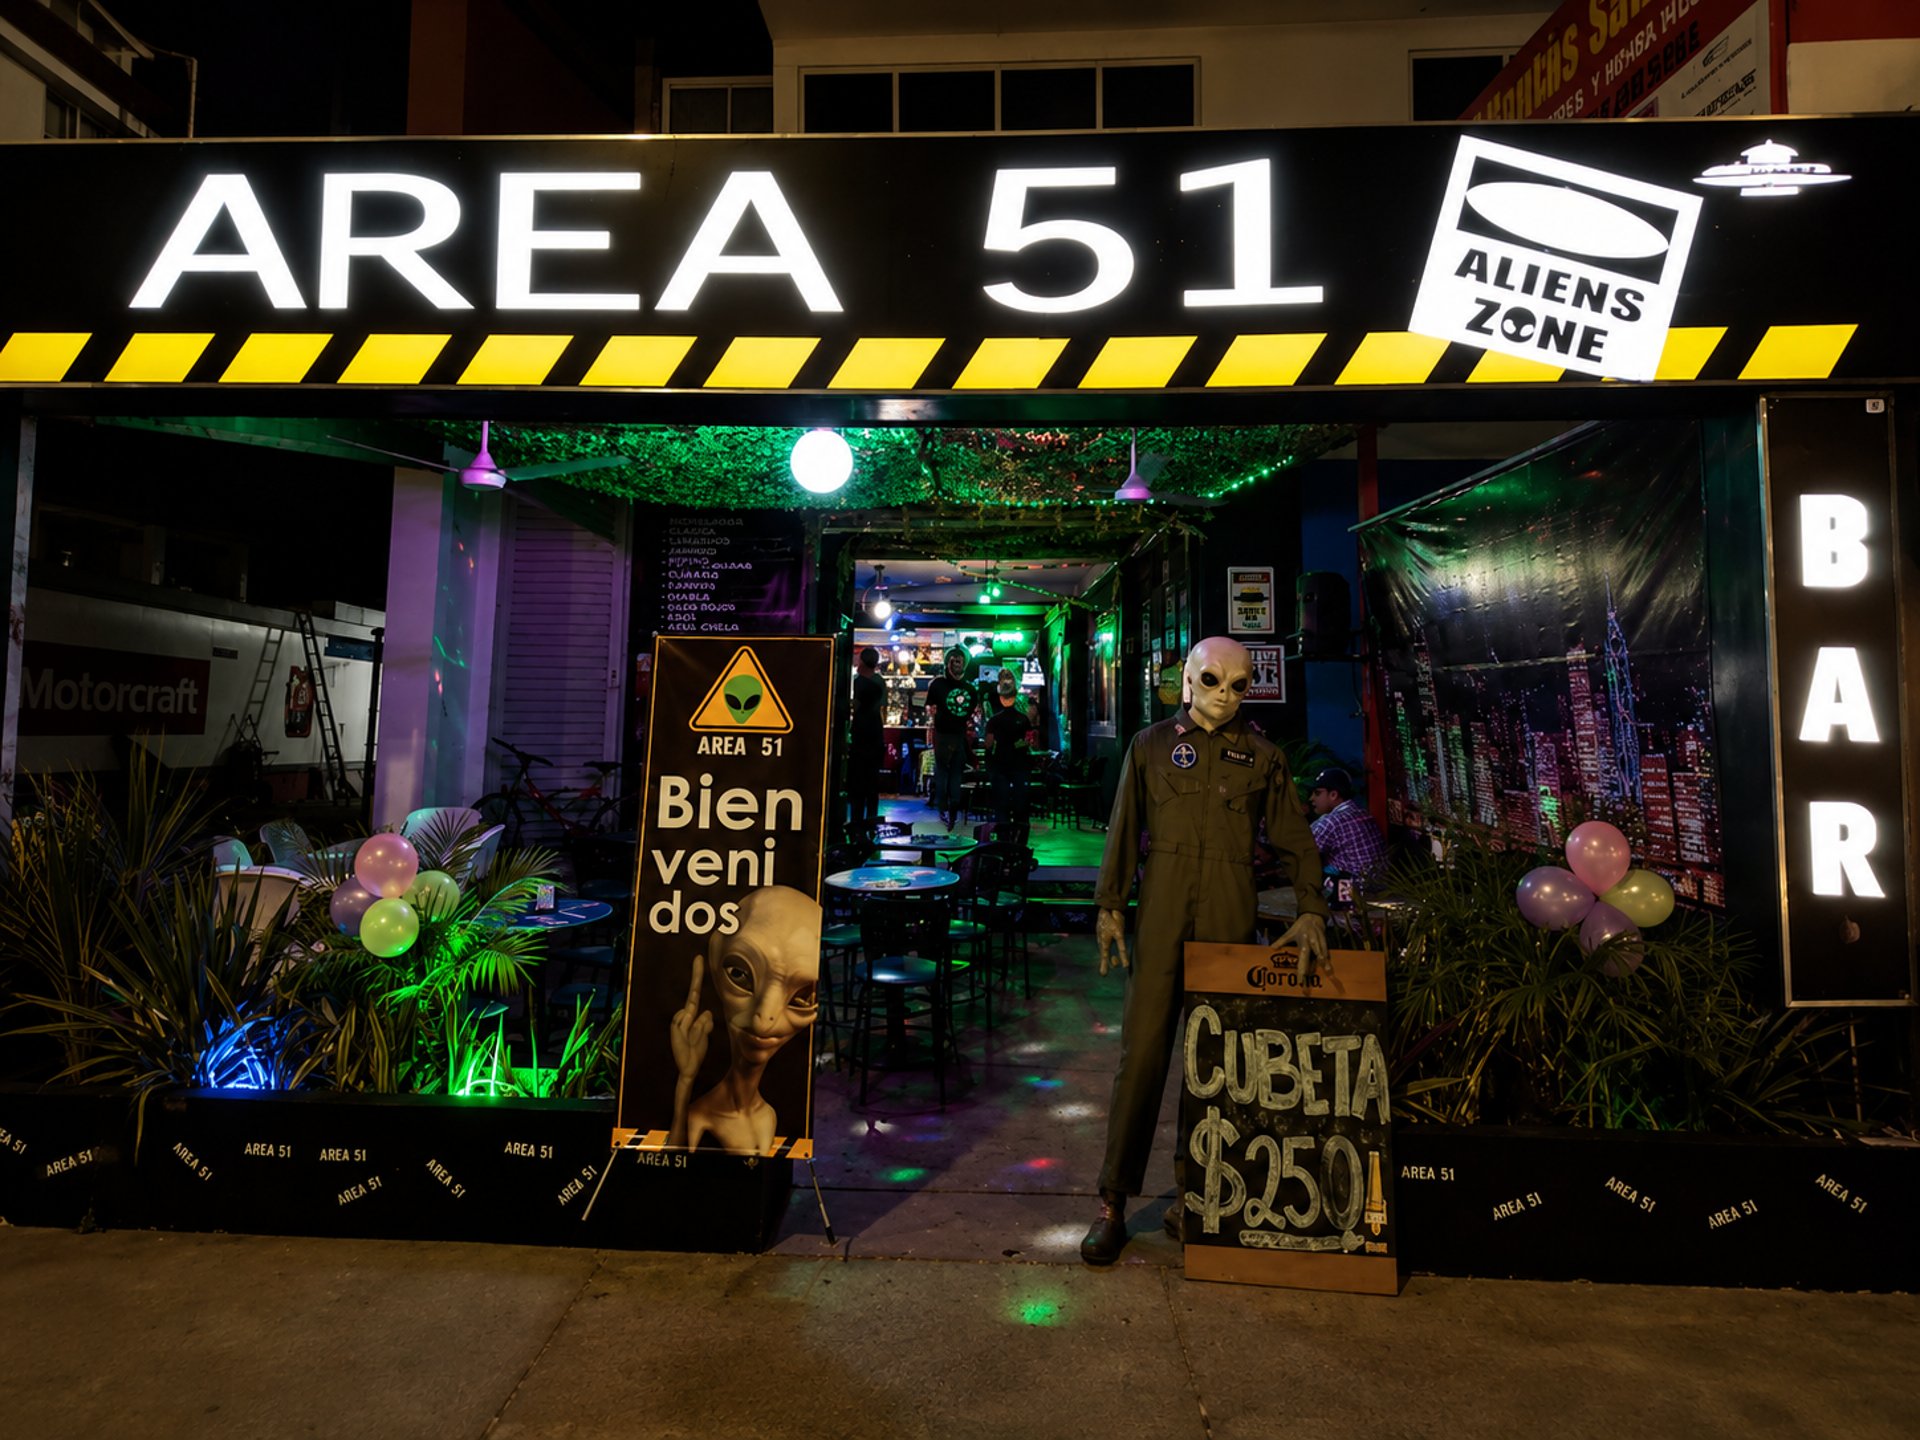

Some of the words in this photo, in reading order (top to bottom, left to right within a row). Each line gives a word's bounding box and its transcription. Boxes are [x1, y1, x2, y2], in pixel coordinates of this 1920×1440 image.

[129, 171, 843, 312] AREA
[983, 159, 1323, 313] 51
[1454, 247, 1645, 323] ALIENS
[20, 667, 198, 714] Motorcraft
[1799, 494, 1886, 899] BAR
[697, 736, 746, 756] AREA
[761, 737, 783, 757] 51
[658, 773, 803, 830] Bien
[652, 837, 775, 886] veni
[650, 890, 740, 935] dos
[1184, 1005, 1391, 1126] CUBETA
[12, 1140, 27, 1155] 51
[46, 1156, 77, 1177] AREA
[79, 1150, 93, 1164] 51
[173, 1142, 198, 1169] AREA
[199, 1166, 213, 1180] 51
[244, 1142, 274, 1157] AREA
[279, 1145, 292, 1158] 51
[320, 1148, 349, 1162] AREA
[354, 1148, 367, 1162] 51
[504, 1142, 535, 1157] AREA
[540, 1145, 553, 1159] 51
[637, 1152, 670, 1167] AREA
[675, 1155, 688, 1168] 51
[337, 1184, 366, 1206] AREA
[368, 1176, 382, 1191] 51
[425, 1159, 451, 1186] AREA
[453, 1184, 467, 1198] 51
[557, 1178, 583, 1206] AREA
[582, 1165, 598, 1182] 51
[1401, 1166, 1435, 1180] AREA
[1440, 1167, 1455, 1181] 51
[1492, 1199, 1525, 1221] AREA
[1526, 1192, 1543, 1207] 51
[1605, 1176, 1637, 1203] AREA
[1639, 1196, 1656, 1213] 51
[1815, 1173, 1848, 1202] AREA
[1850, 1197, 1868, 1214] 51
[1708, 1207, 1741, 1230] AREA
[1742, 1200, 1758, 1215] 51
